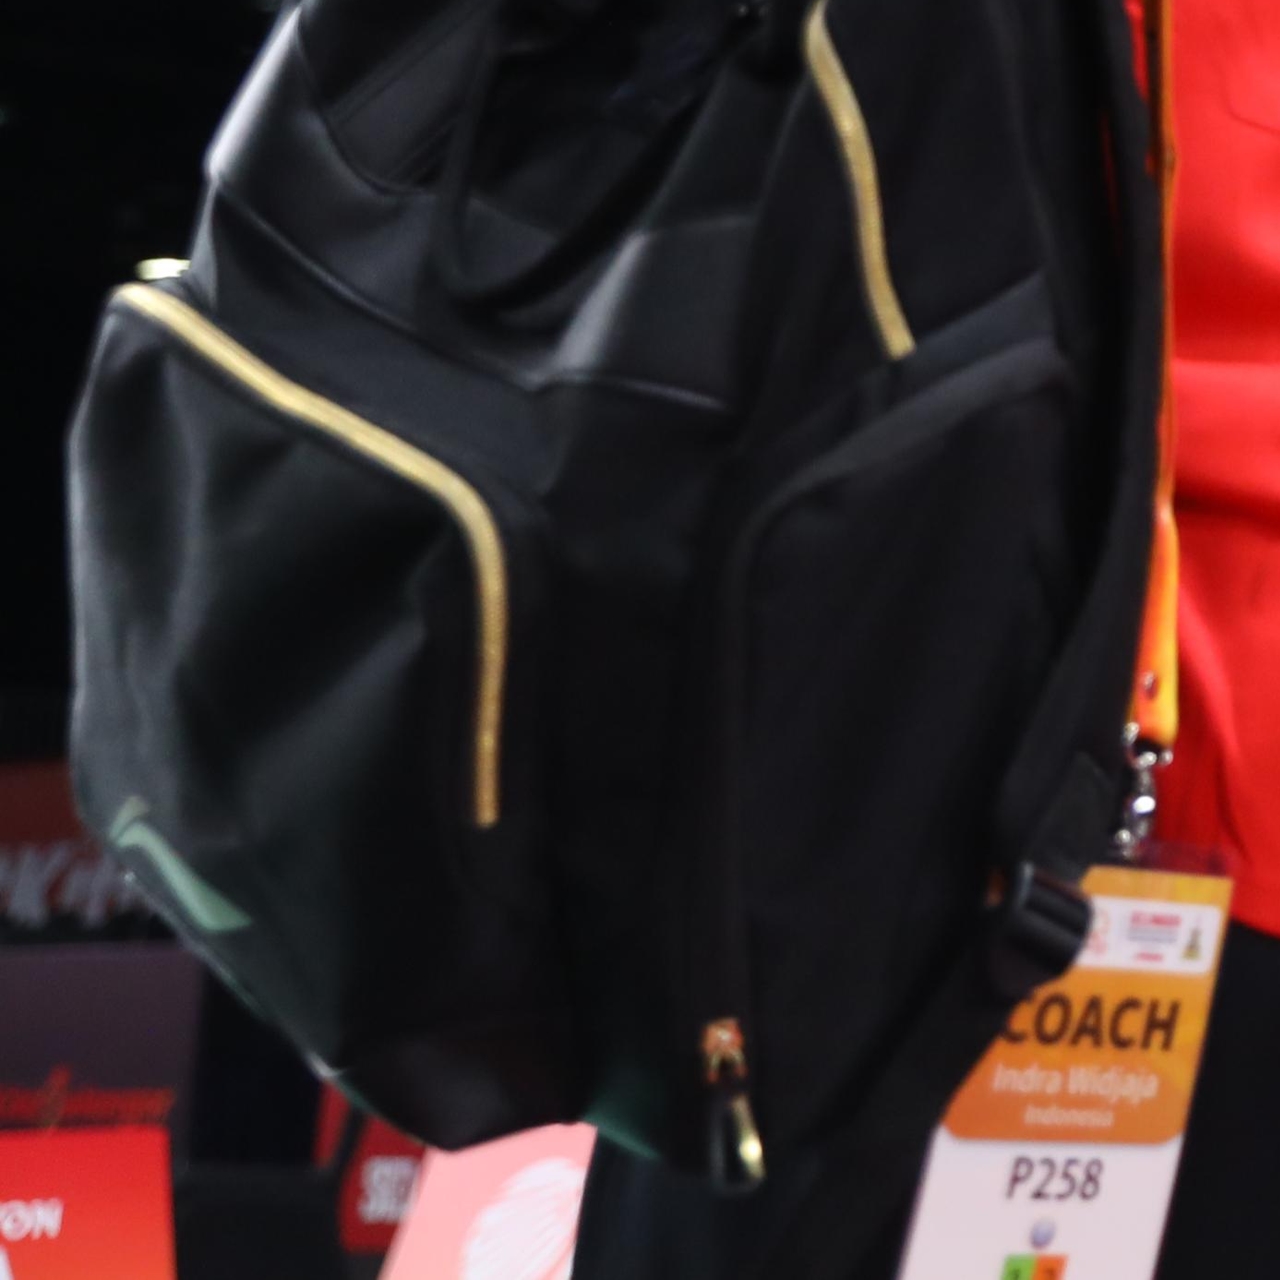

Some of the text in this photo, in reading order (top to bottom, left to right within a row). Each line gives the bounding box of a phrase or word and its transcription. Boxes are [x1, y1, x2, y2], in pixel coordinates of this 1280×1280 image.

[992, 1062, 1063, 1094] Indra
[1005, 1157, 1105, 1201] P258
[0, 1198, 64, 1241] ON
